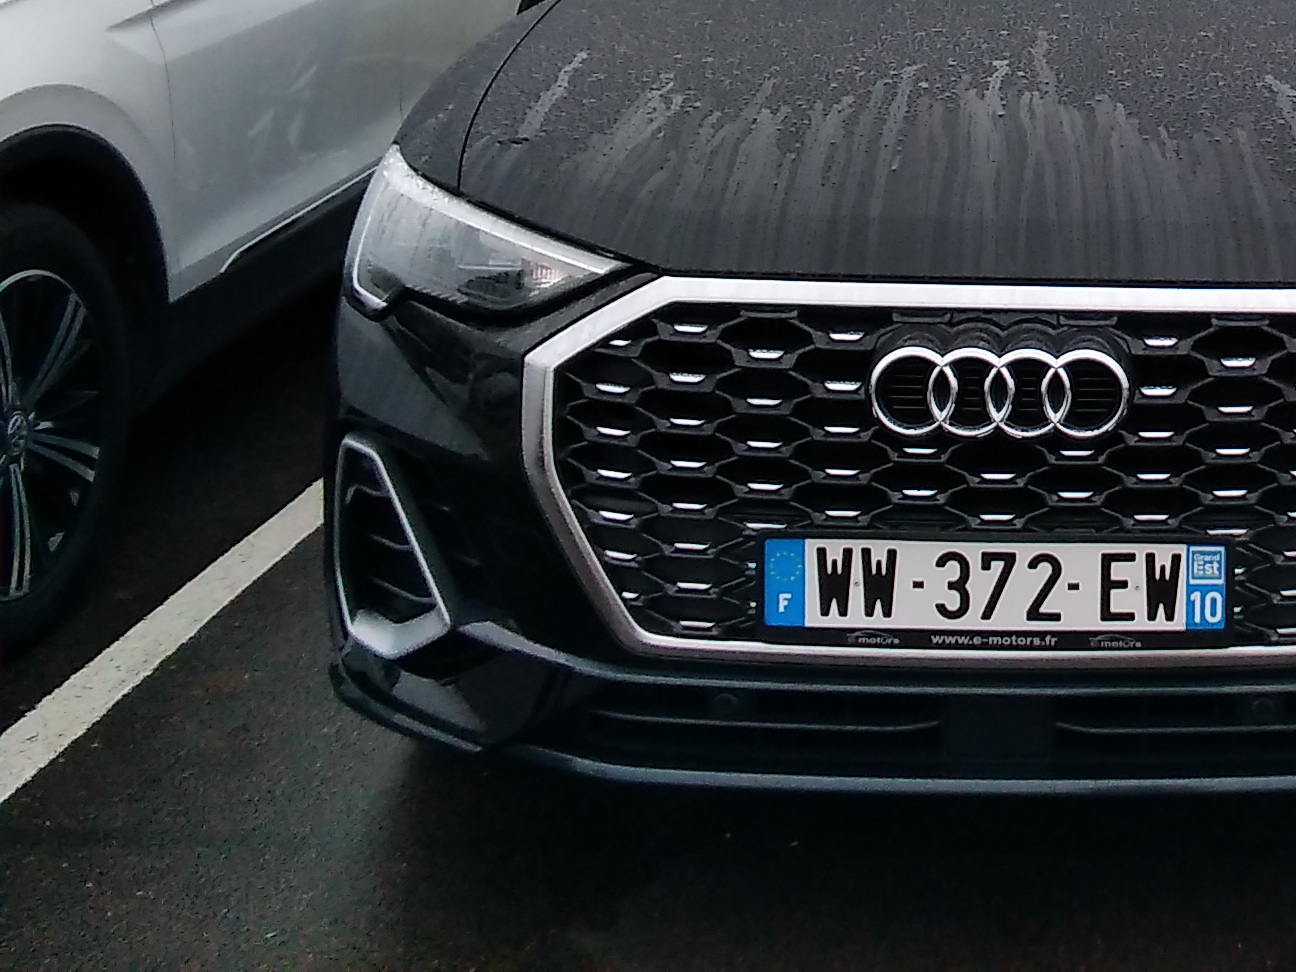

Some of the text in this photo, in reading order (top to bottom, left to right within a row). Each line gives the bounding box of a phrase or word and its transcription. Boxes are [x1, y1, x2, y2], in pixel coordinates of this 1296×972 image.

[1193, 553, 1220, 561] Grand
[1193, 561, 1220, 575] Est
[778, 593, 792, 613] F
[1190, 591, 1223, 623] 10
[930, 634, 1058, 646] www.e-motors.fr
